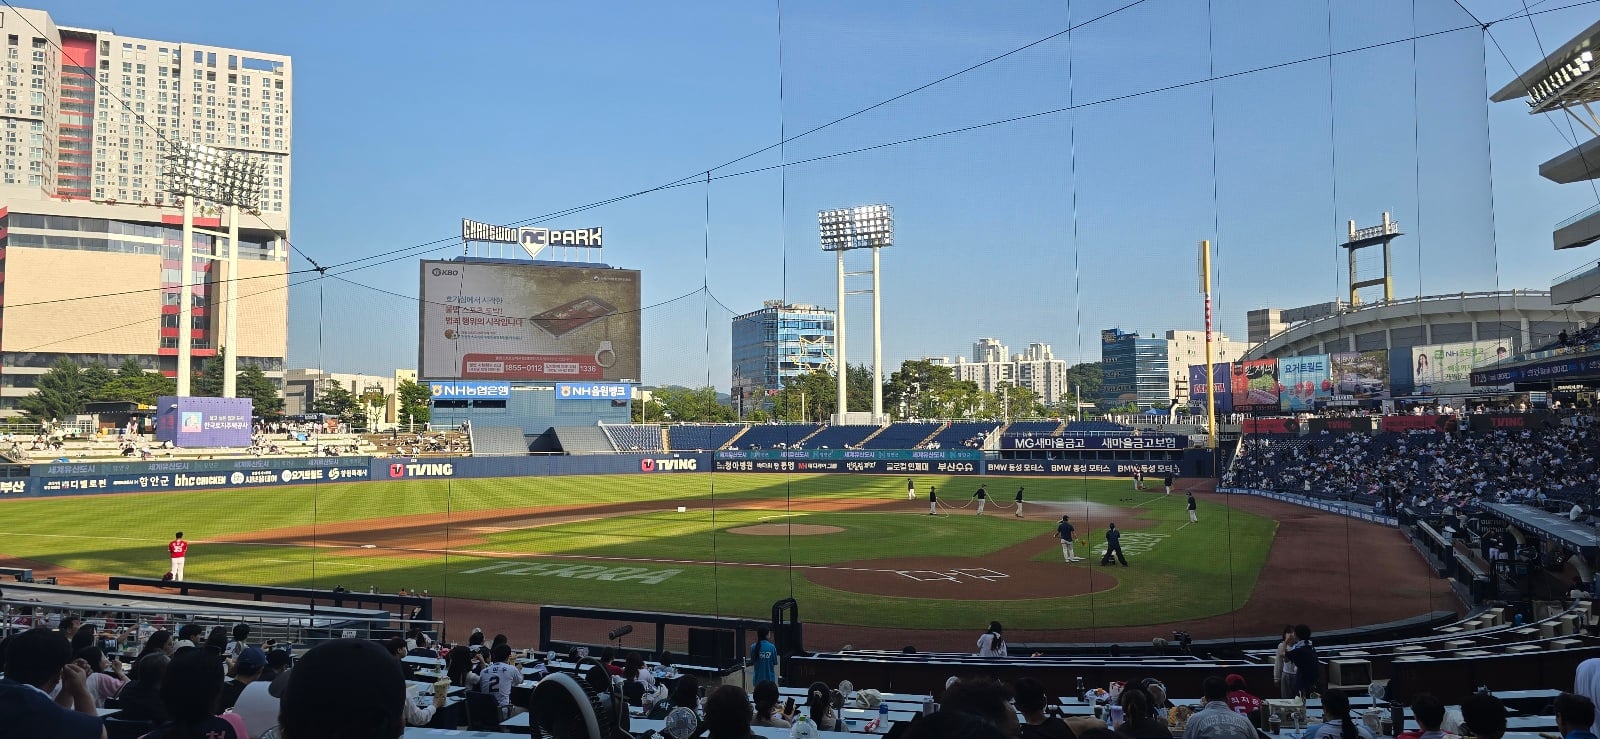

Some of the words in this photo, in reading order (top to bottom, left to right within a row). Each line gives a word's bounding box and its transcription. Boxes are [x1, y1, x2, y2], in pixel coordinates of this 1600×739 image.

[463, 219, 517, 242] CHANGWON
[522, 230, 546, 244] NC
[550, 228, 601, 246] PARK
[446, 296, 480, 304] 호기심에서
[446, 316, 460, 326] 범죄
[462, 316, 484, 326] 행위의
[486, 317, 522, 326] 시작입니다
[1284, 362, 1324, 374] 요거트월드
[444, 385, 508, 396] NH농협은행
[1490, 418, 1524, 426] TVING
[48, 465, 95, 474] 세계유산도시
[148, 462, 189, 471] 세계유산도시
[407, 464, 452, 476] TVING
[656, 459, 696, 471] TVING
[725, 461, 752, 470] 청아병원
[886, 462, 906, 471] 글로컬
[938, 462, 973, 472] 부산우유
[291, 470, 323, 480] 요거트월드
[340, 468, 367, 478] 창원특례시
[139, 476, 169, 487] 함안군
[175, 474, 196, 486] bhc
[196, 476, 226, 486] CHICKEN
[0, 481, 25, 493] 부산
[459, 561, 684, 584] TERRA
[489, 676, 499, 692] 2
[1199, 714, 1219, 730] UNDER
